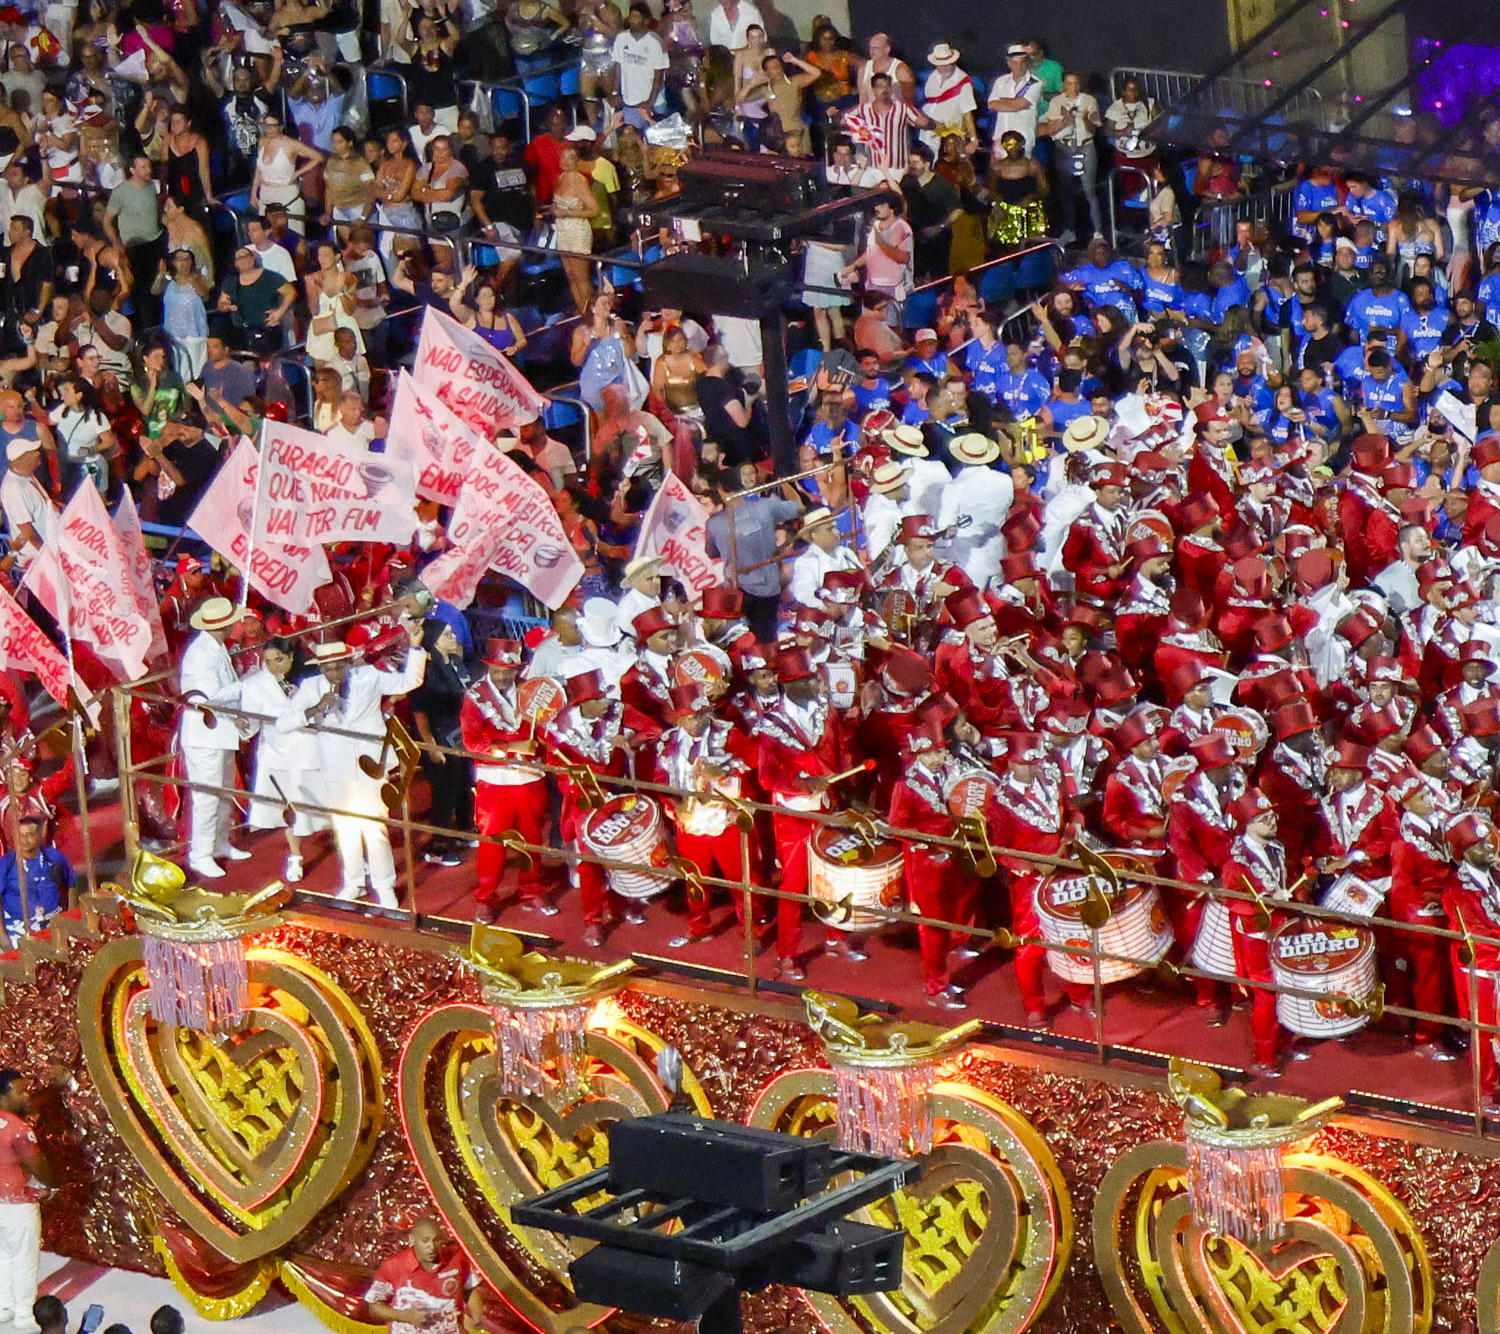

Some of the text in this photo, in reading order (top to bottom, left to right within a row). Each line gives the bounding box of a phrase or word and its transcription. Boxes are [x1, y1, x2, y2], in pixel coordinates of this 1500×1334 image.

[423, 343, 462, 375] NÃO
[268, 472, 305, 503] QUE
[266, 507, 383, 538] VAI TER FIM
[1279, 931, 1328, 948] VIRA
[1279, 936, 1361, 959] DOURO
